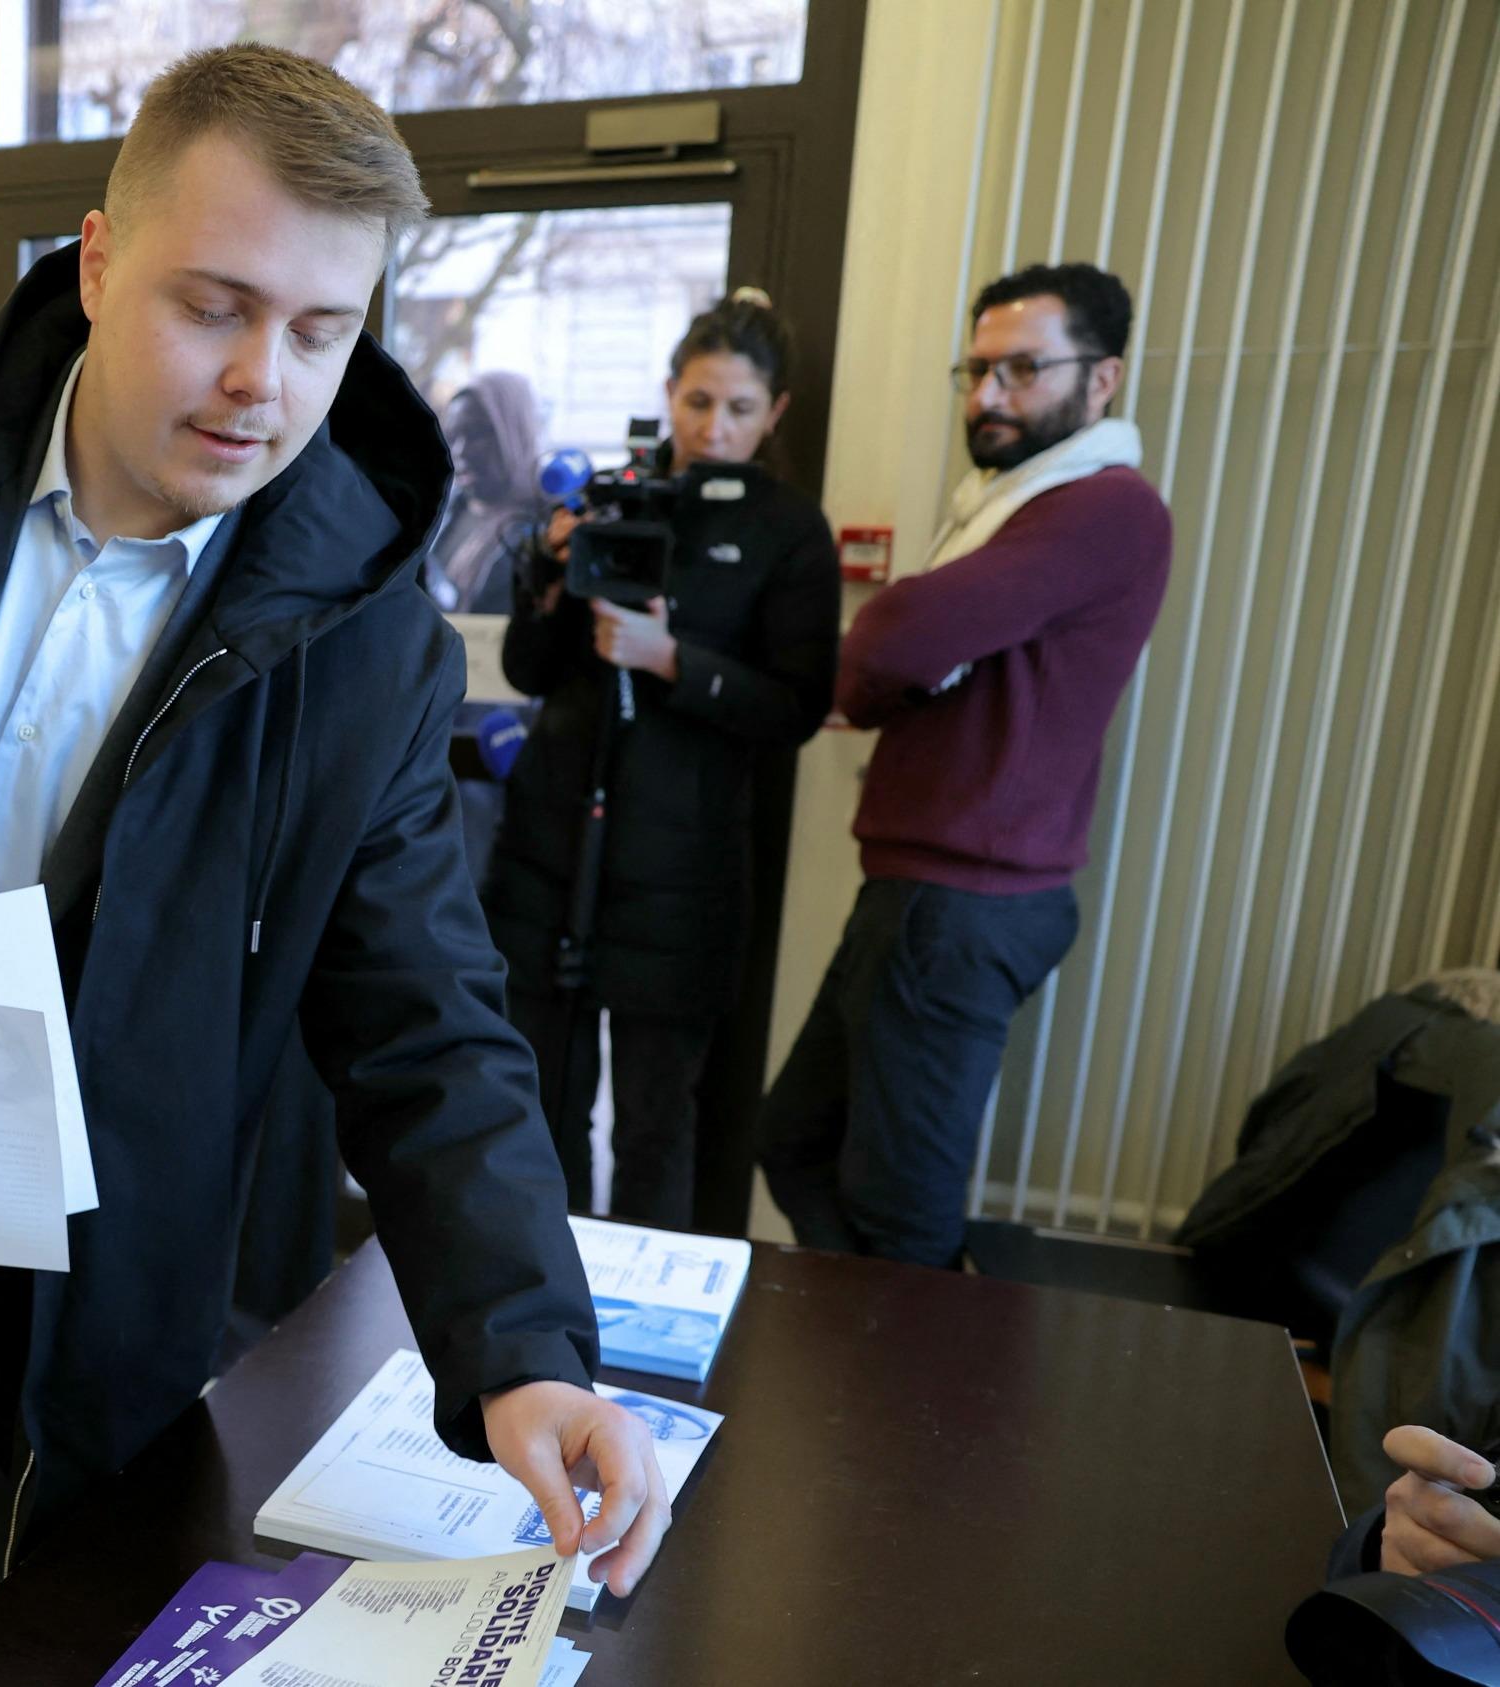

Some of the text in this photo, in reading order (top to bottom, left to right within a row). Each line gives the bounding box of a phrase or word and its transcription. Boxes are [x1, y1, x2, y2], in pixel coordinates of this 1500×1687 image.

[477, 1570, 508, 1608] AVEC
[524, 1571, 533, 1582] ET
[497, 1562, 556, 1654] DIGNITÉ,
[452, 1610, 489, 1654] LOUIS
